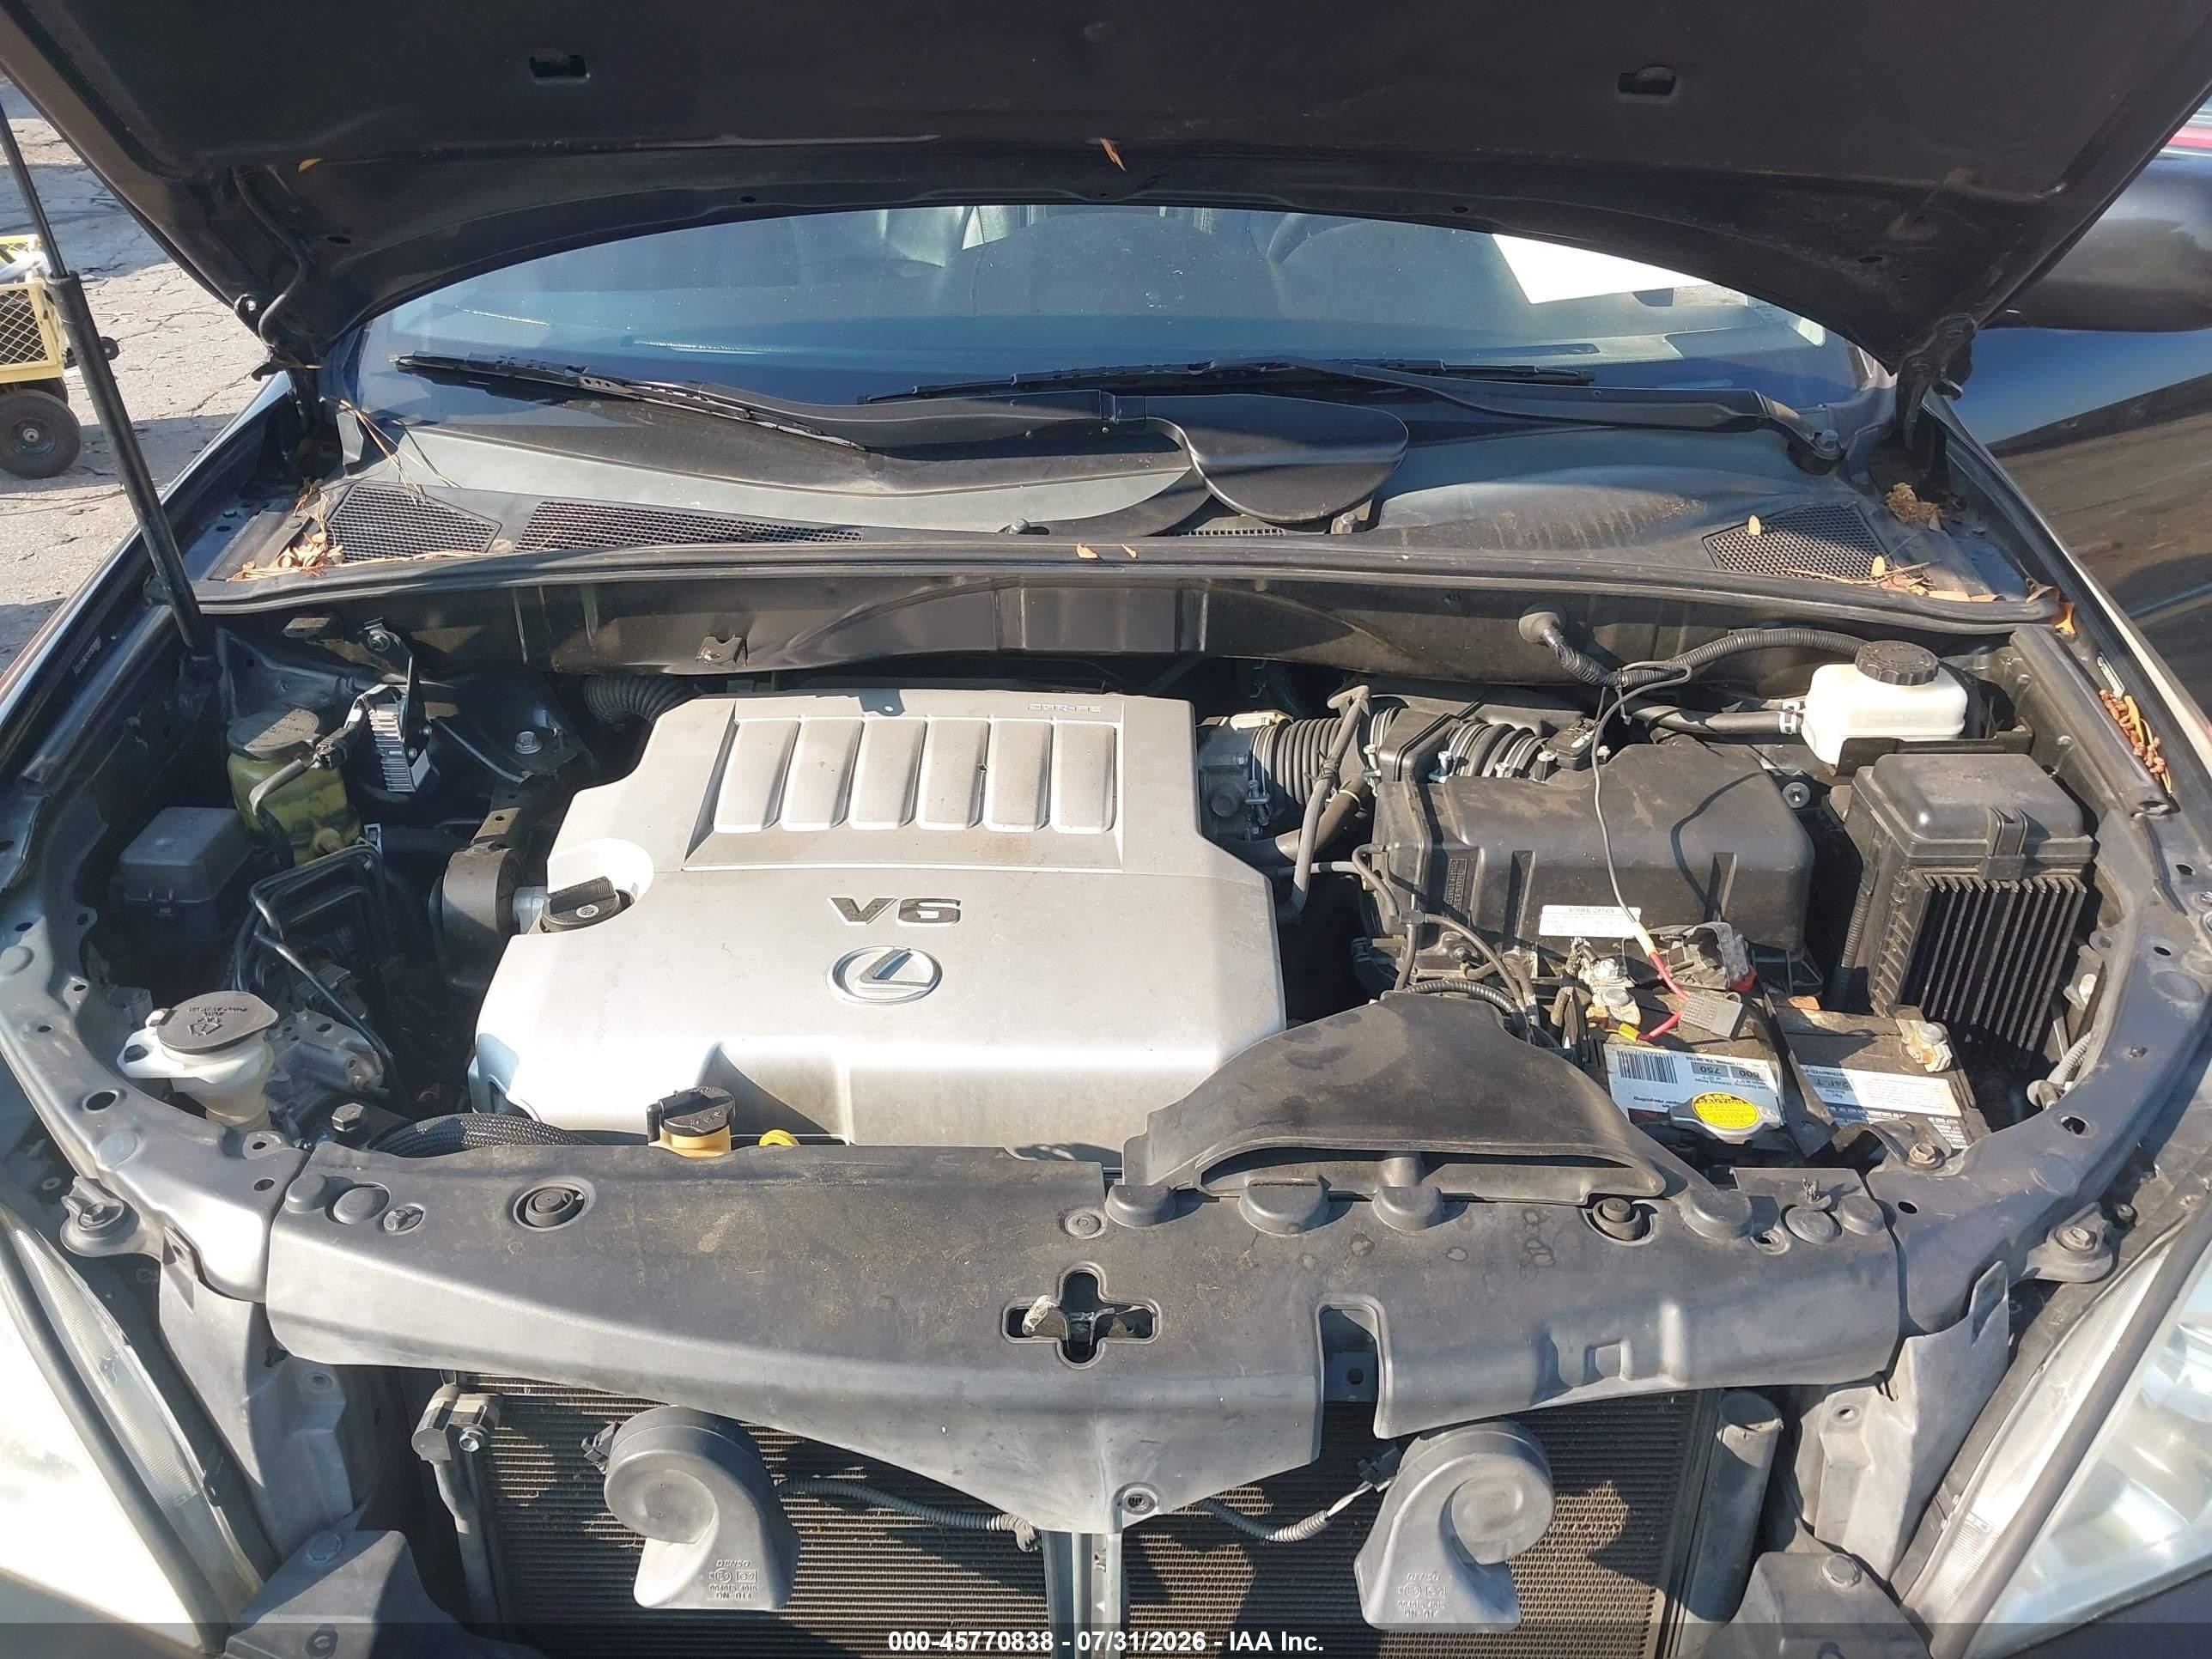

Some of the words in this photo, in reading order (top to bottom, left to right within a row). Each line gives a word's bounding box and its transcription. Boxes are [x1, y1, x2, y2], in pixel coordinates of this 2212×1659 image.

[826, 896, 963, 927] V6
[1567, 906, 1615, 915] NORMALIZATION
[1699, 1066, 1722, 1074] 750
[716, 1559, 751, 1567] DENSO
